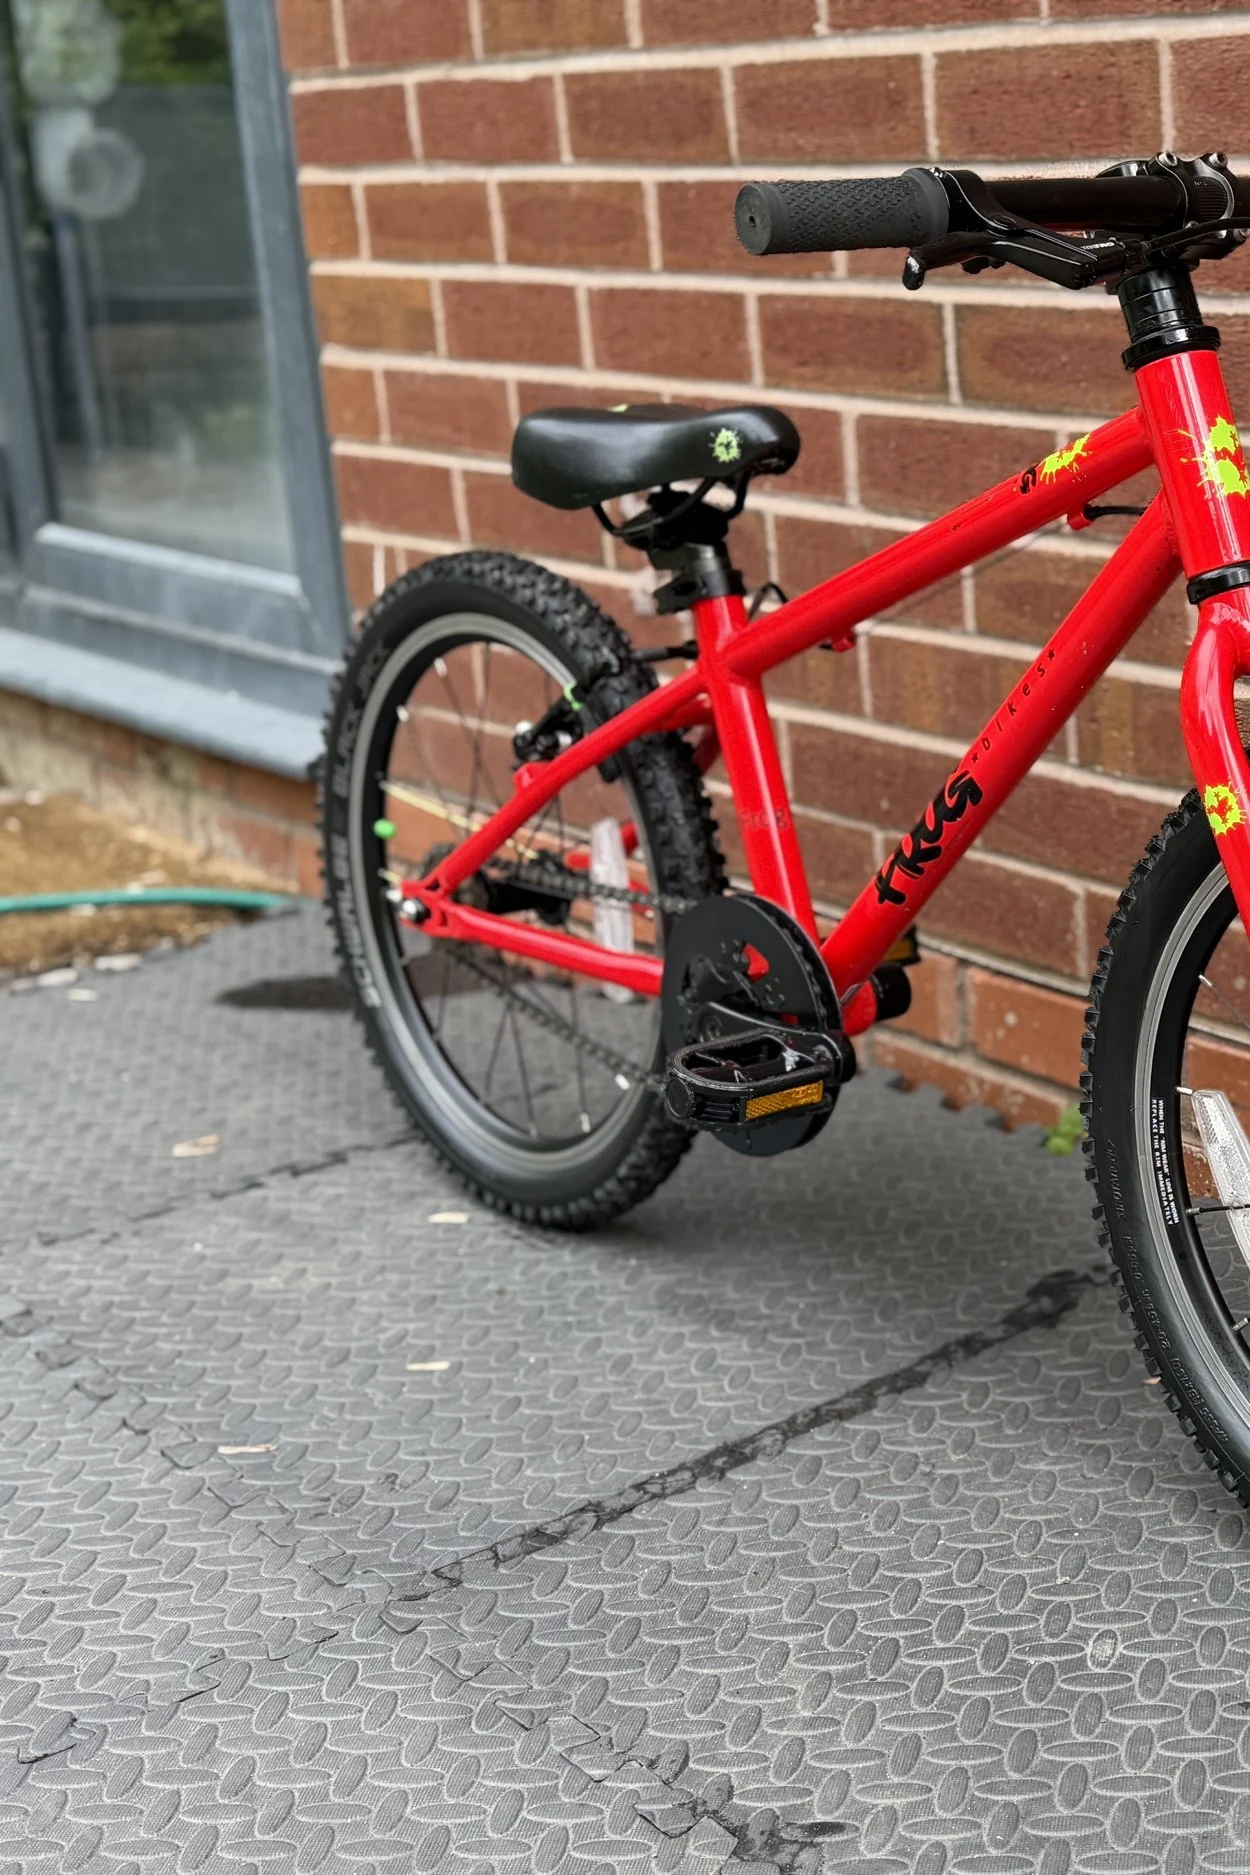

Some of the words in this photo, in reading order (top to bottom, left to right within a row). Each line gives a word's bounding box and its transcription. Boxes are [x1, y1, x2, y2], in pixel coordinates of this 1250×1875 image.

[980, 662, 1047, 752] bikes
[1151, 1099, 1159, 1133] REPLACE
[1157, 1170, 1174, 1225] IMMEDIATELY
[1170, 1201, 1180, 1224] WORN
